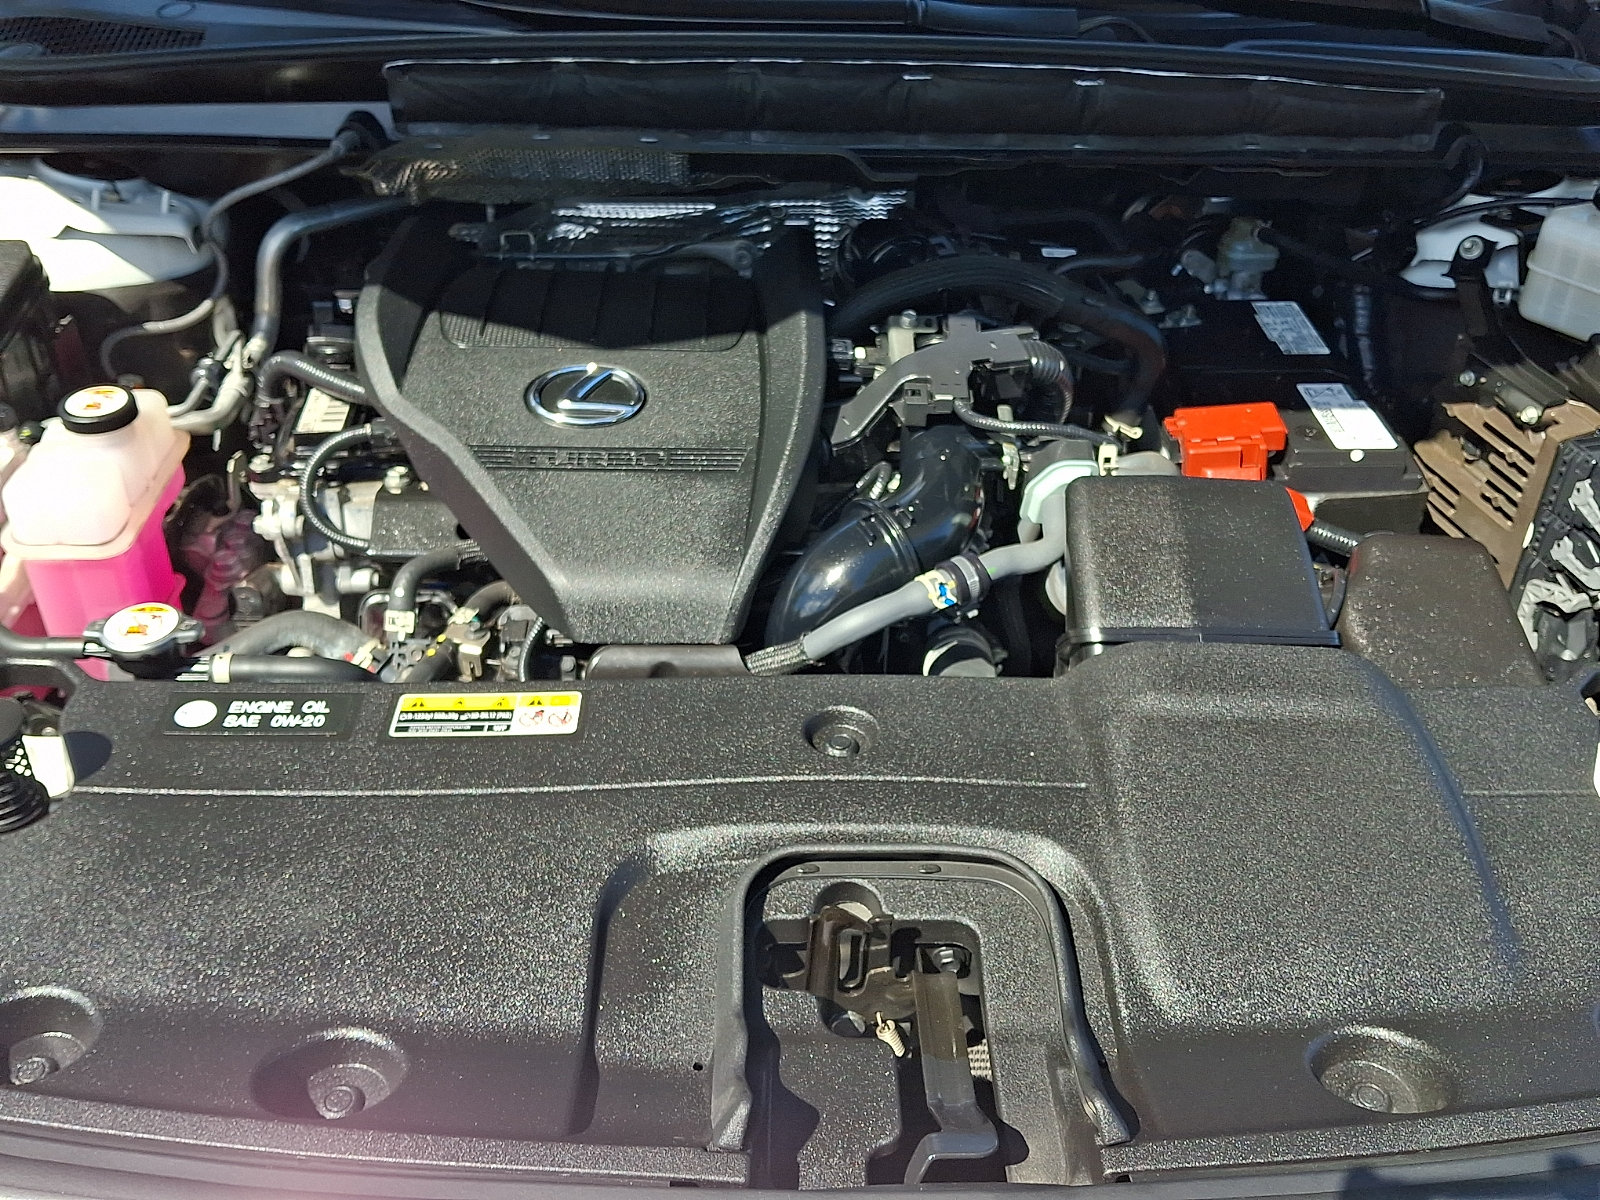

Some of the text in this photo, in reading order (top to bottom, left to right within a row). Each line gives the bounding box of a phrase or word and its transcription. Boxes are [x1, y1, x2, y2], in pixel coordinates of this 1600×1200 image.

[227, 700, 330, 714] ENGINE OIL
[222, 714, 326, 728] SAE 0W-20
